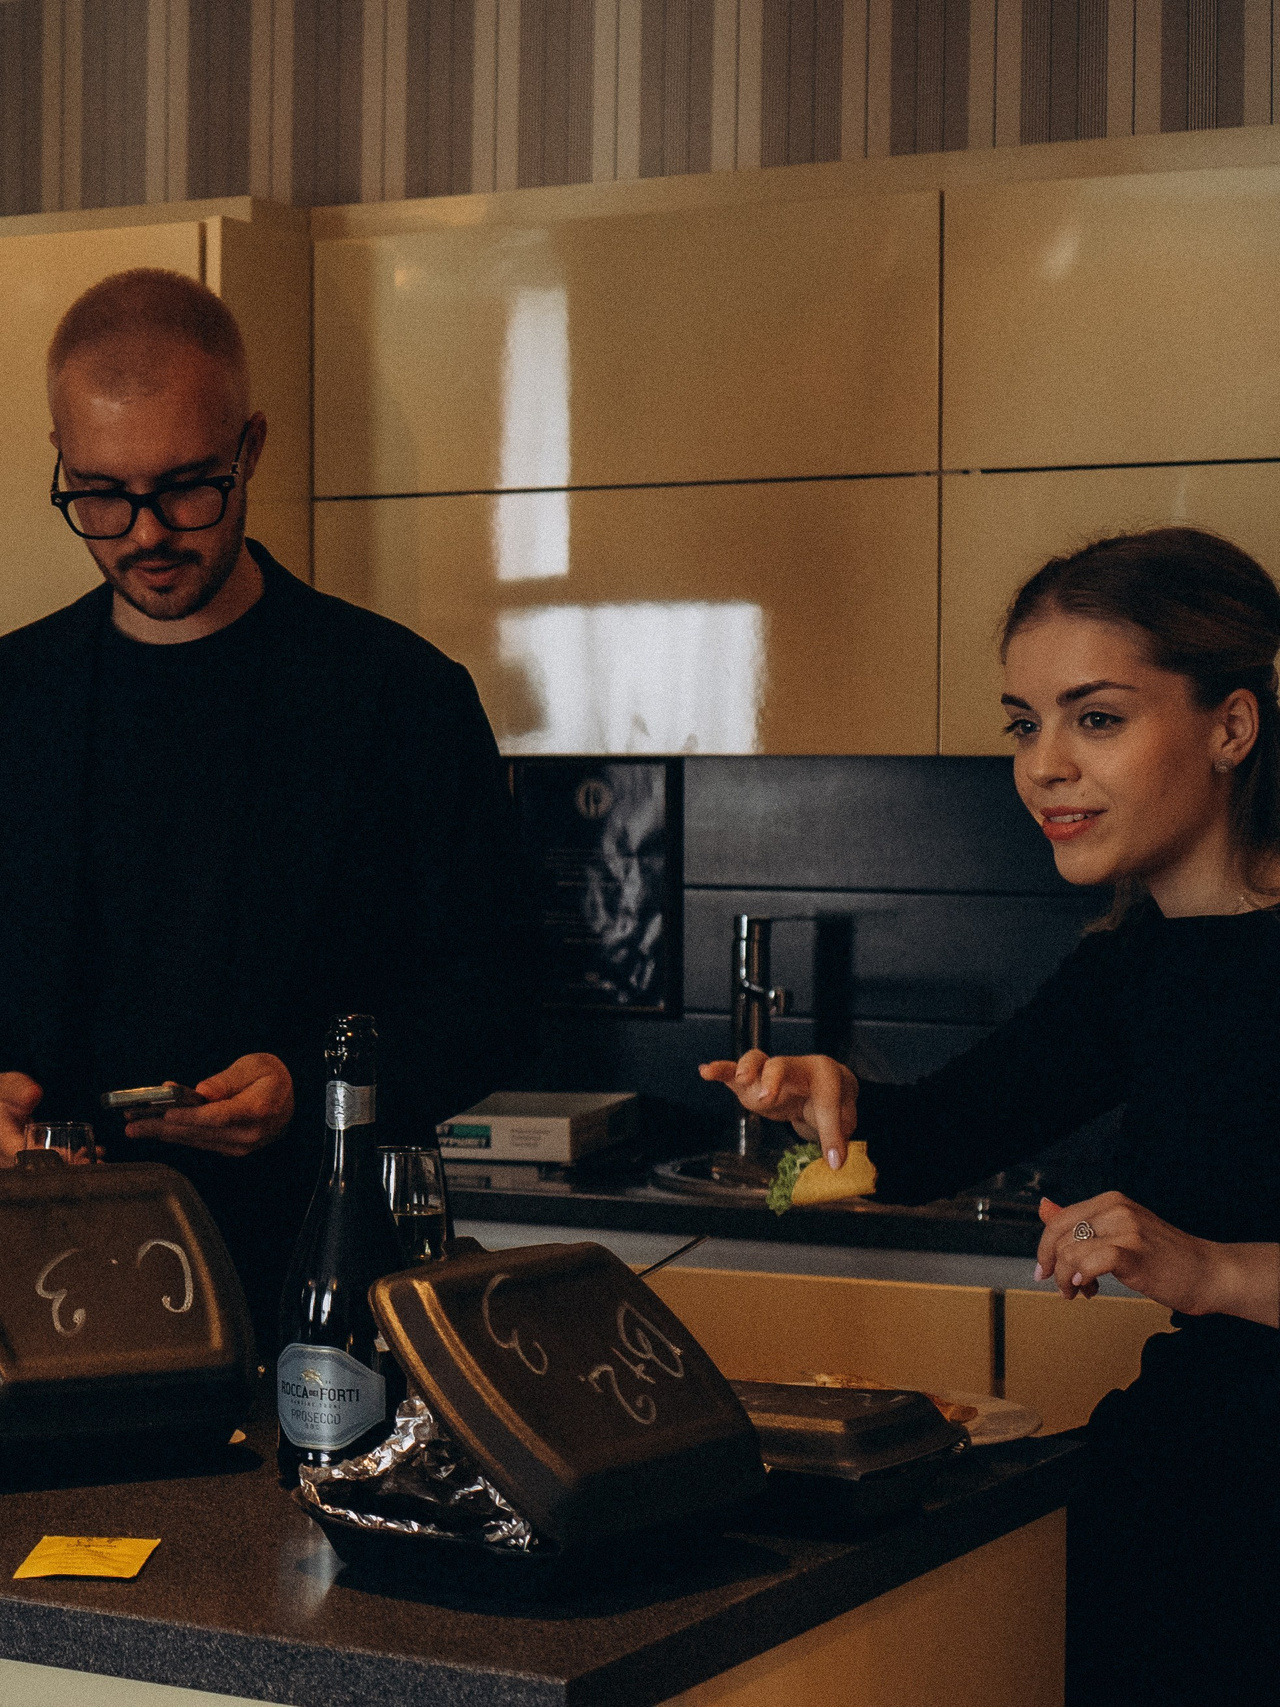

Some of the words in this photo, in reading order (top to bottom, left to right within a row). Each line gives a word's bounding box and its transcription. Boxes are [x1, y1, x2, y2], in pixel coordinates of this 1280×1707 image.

[281, 1380, 309, 1399] ROCCA
[319, 1388, 360, 1402] FORTI
[291, 1408, 340, 1425] PROSECCO
